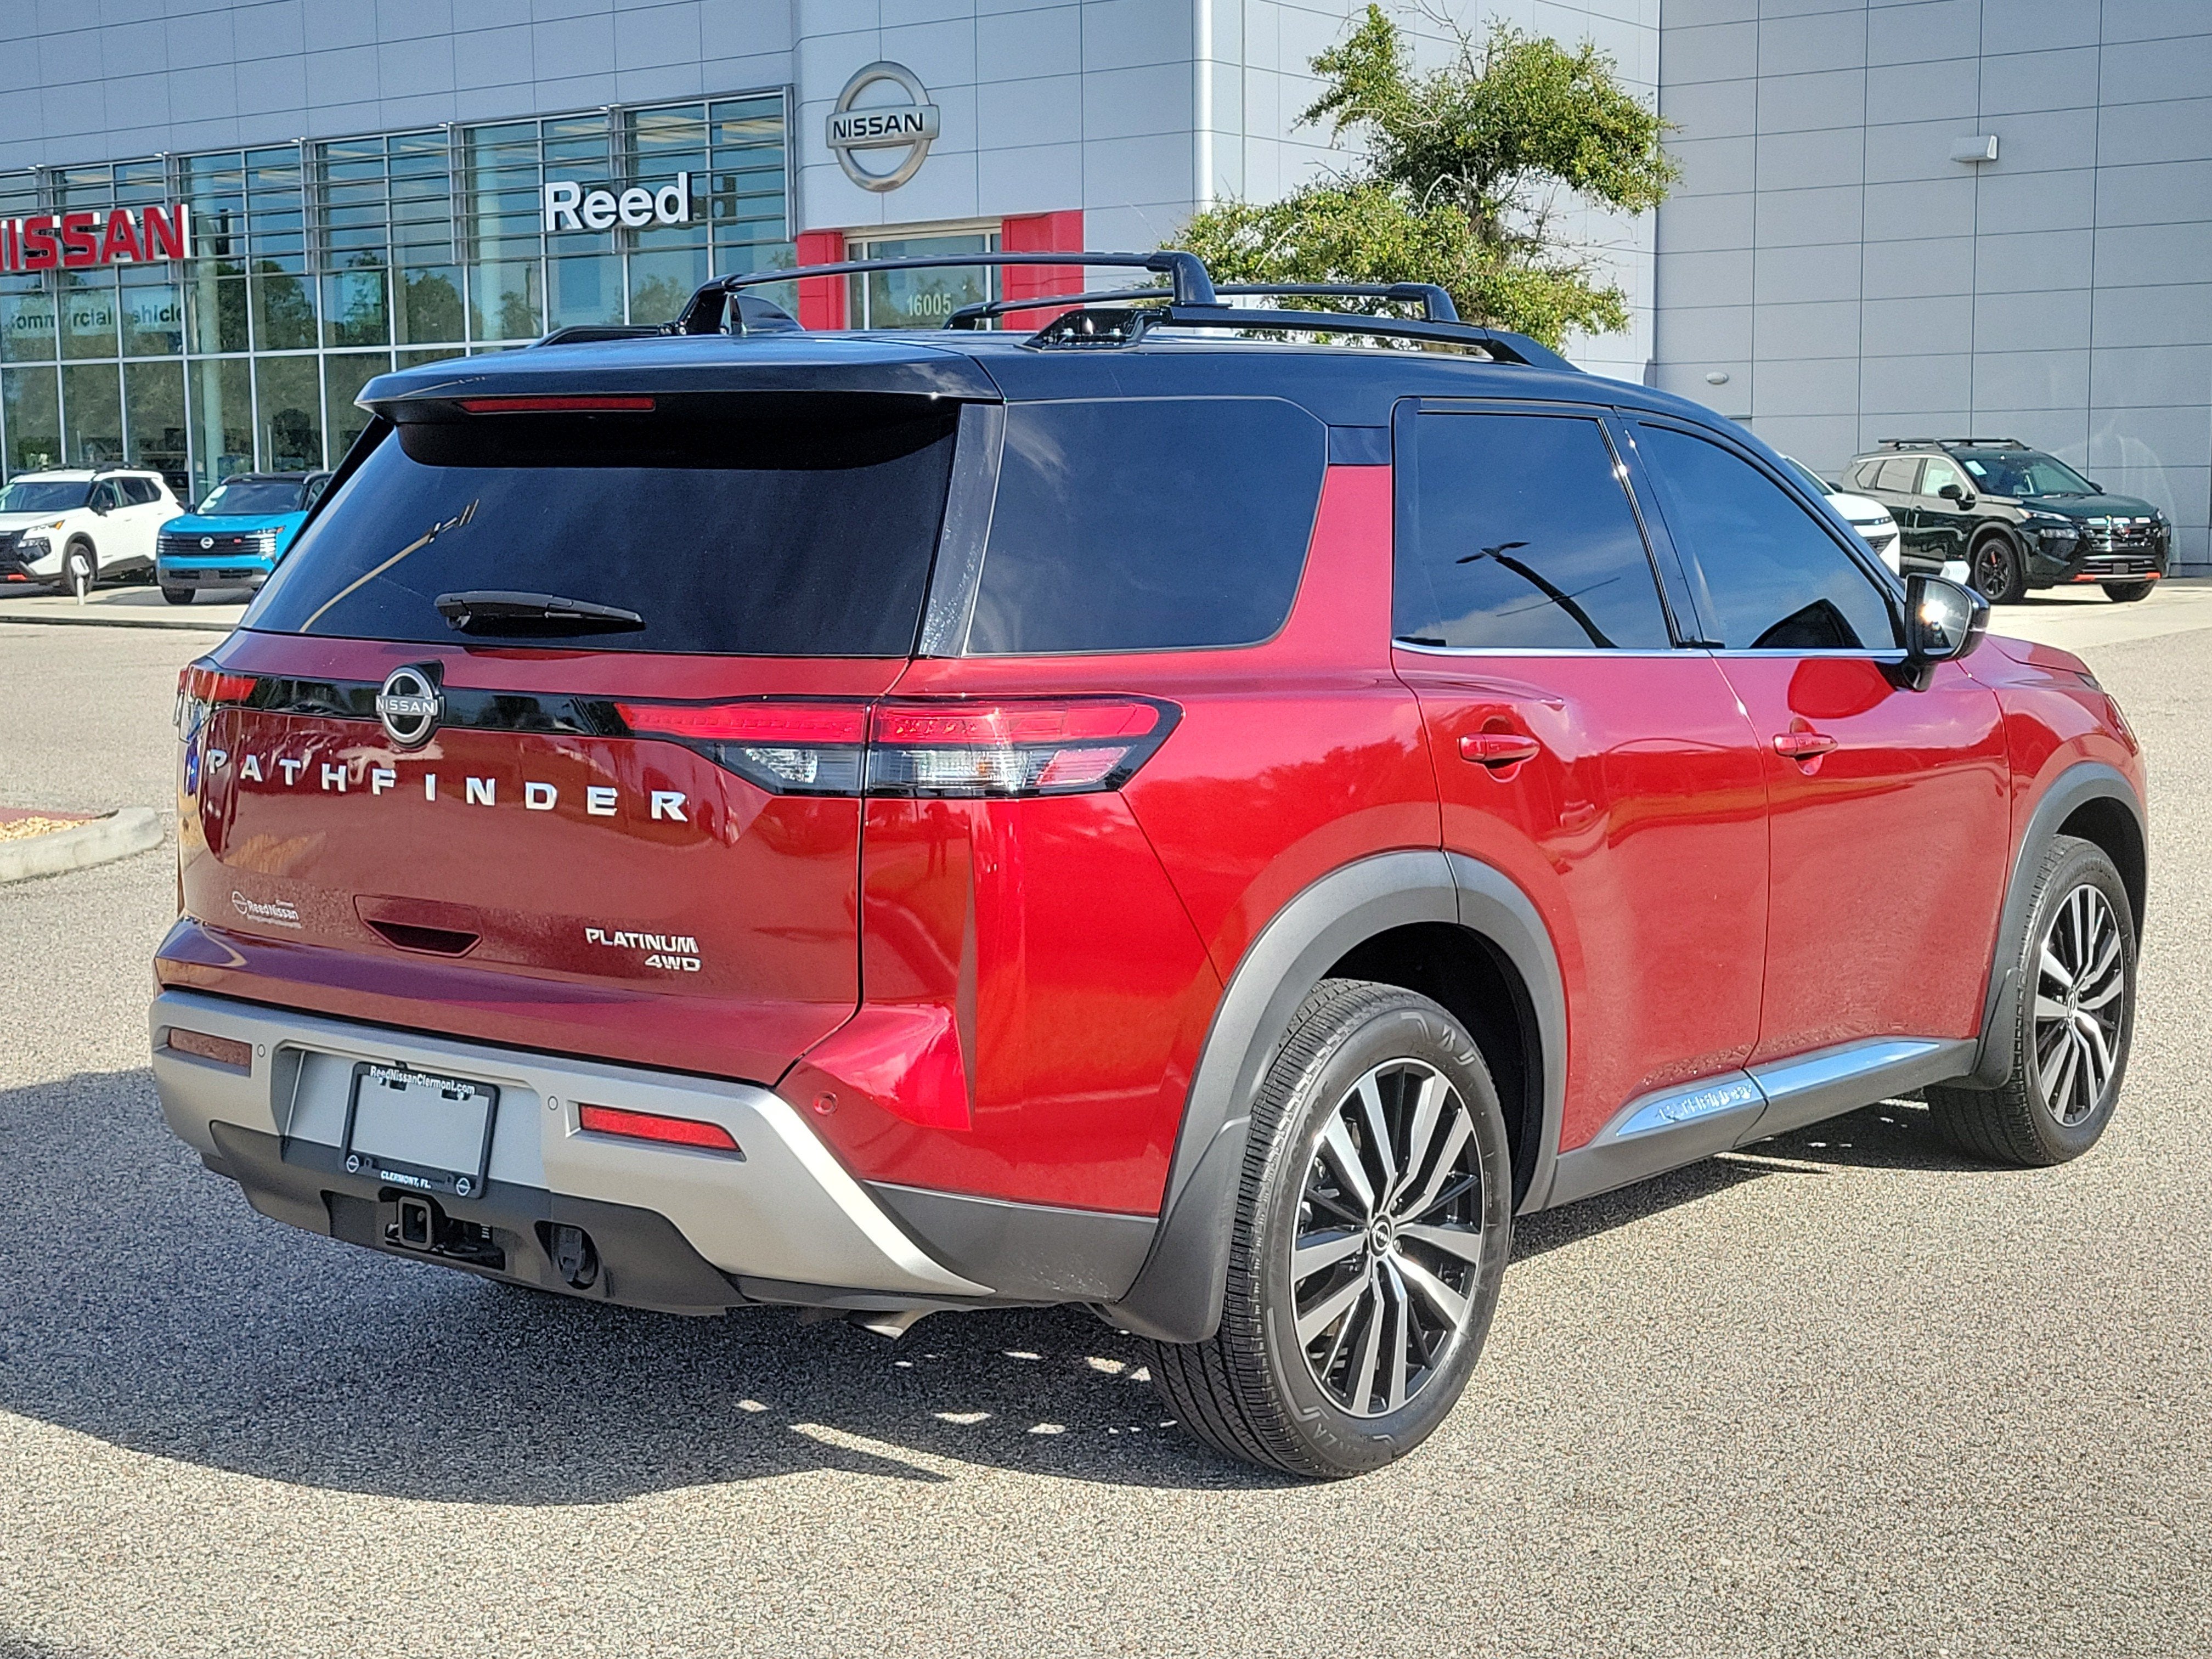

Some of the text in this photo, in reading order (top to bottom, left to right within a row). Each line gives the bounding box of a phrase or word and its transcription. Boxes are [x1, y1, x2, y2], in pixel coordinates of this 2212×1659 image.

[833, 112, 923, 140] NISSAN
[545, 171, 690, 232] Reed
[0, 204, 190, 272] ISSAN
[11, 306, 111, 330] ommrcial
[908, 293, 951, 317] 16005
[377, 698, 435, 713] NISSAN
[207, 748, 688, 822] PATHFINDER
[585, 927, 699, 953] PLATINUM
[645, 954, 702, 972] 4WD
[370, 1065, 475, 1095] ReedNissanClermont.com
